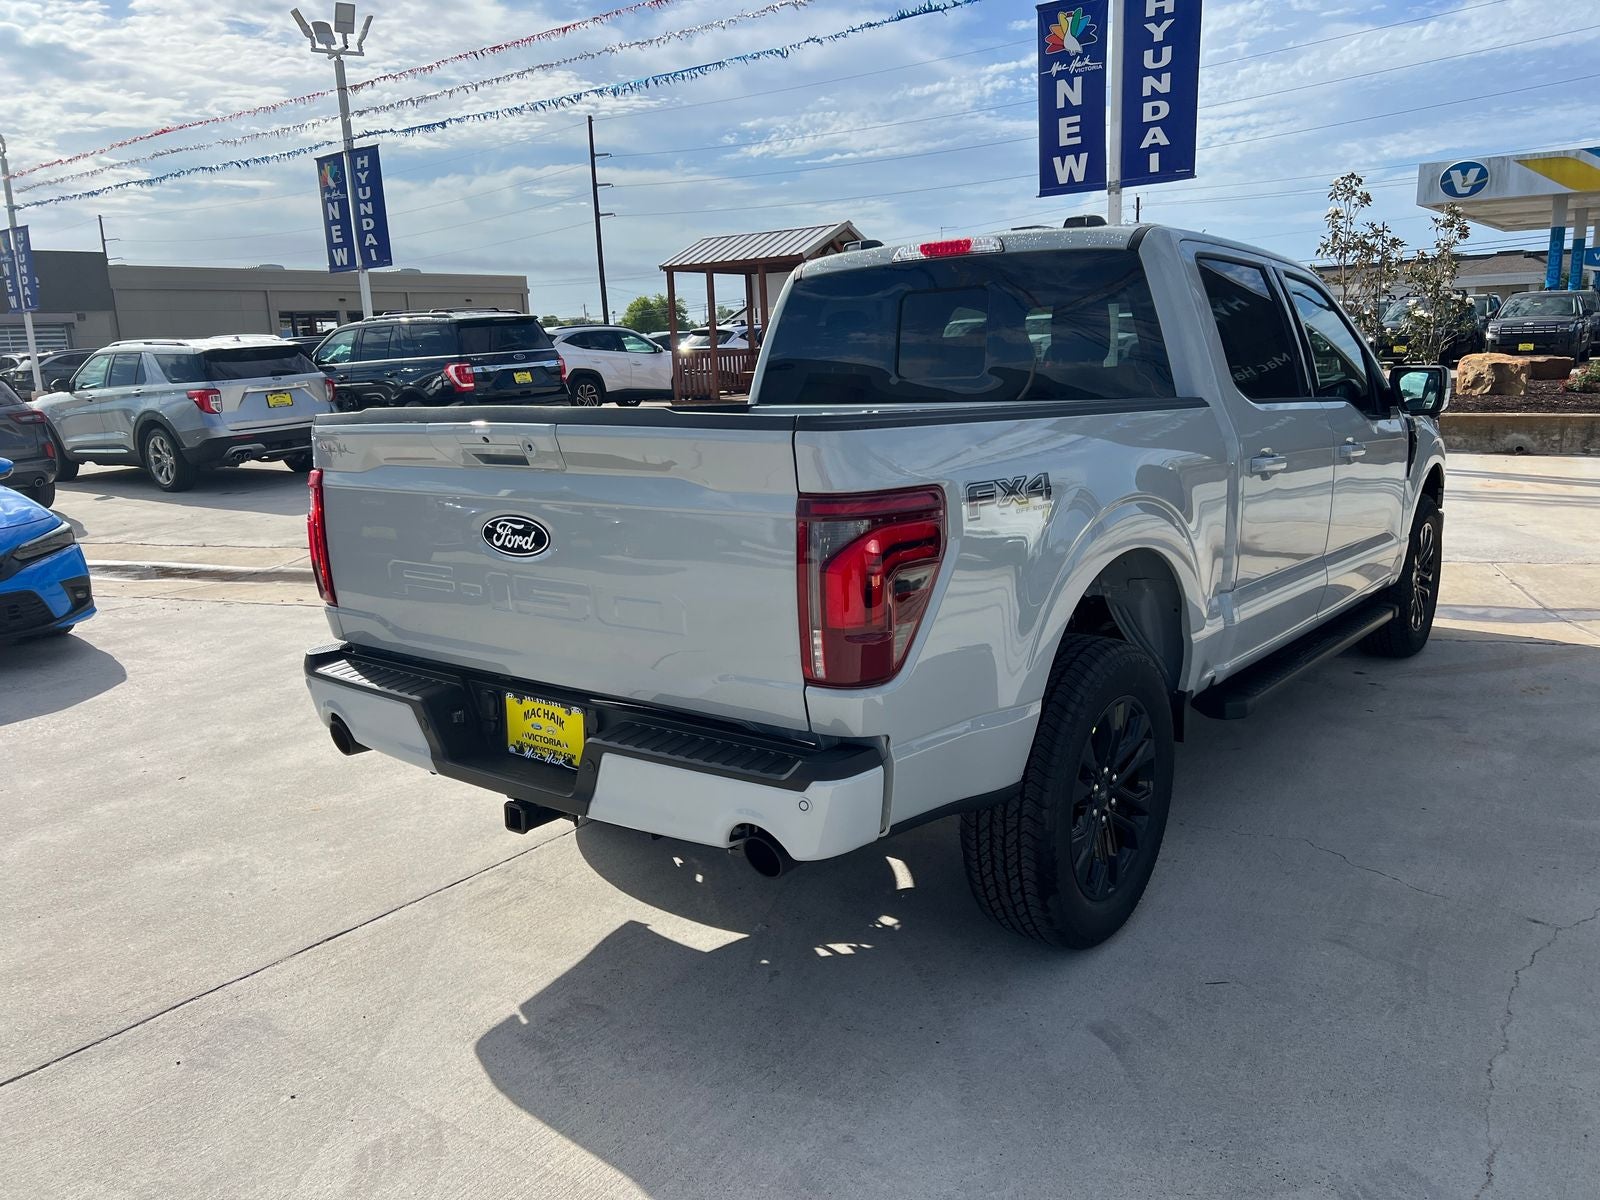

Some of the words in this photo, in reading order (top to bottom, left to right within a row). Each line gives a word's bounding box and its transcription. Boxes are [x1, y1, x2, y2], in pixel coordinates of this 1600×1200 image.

[1075, 64, 1103, 74] VICTORIA
[1139, 0, 1175, 173] HYUNDAI
[1053, 76, 1088, 184] NEW
[356, 155, 378, 261] HYUNDAI
[327, 201, 348, 266] NEW
[3, 263, 17, 308] NEW
[17, 232, 31, 306] HYUNDAI
[966, 472, 1051, 521] FX4
[493, 521, 535, 550] Ford
[388, 559, 687, 635] F-150
[524, 708, 542, 721] MAC
[543, 709, 565, 730] HAIK
[527, 732, 562, 748] VICTORIA
[524, 747, 544, 760] Mac
